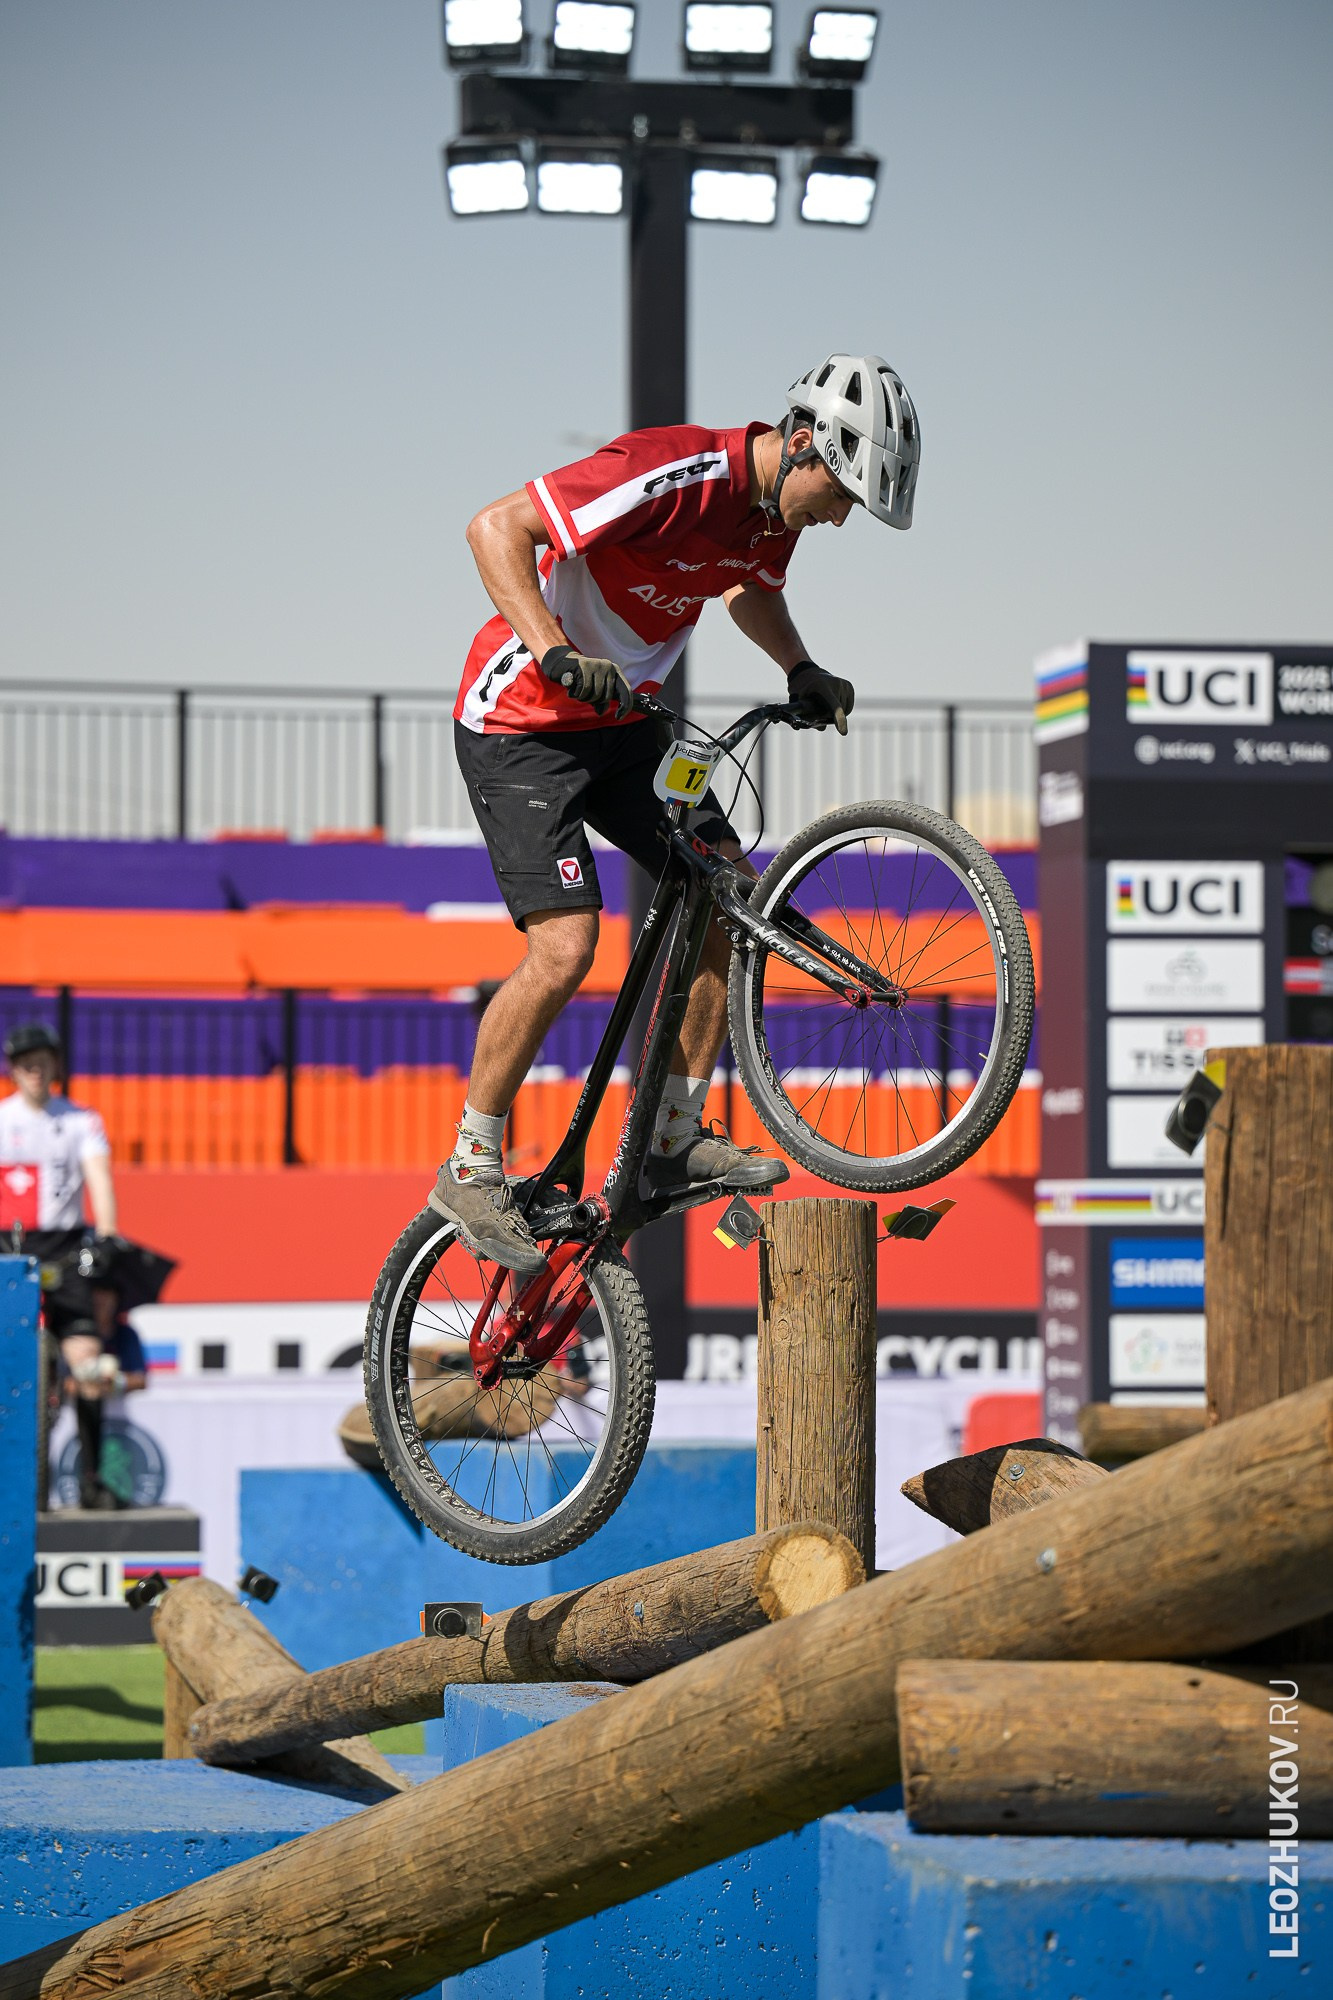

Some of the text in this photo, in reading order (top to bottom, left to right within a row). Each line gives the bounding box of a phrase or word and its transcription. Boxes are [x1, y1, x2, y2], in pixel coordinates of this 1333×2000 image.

[643, 460, 722, 495] FELT
[1158, 669, 1255, 707] UCI
[1278, 690, 1333, 715] WOR
[685, 768, 707, 791] 17
[1143, 878, 1241, 915] UCI
[1156, 1189, 1204, 1215] UC
